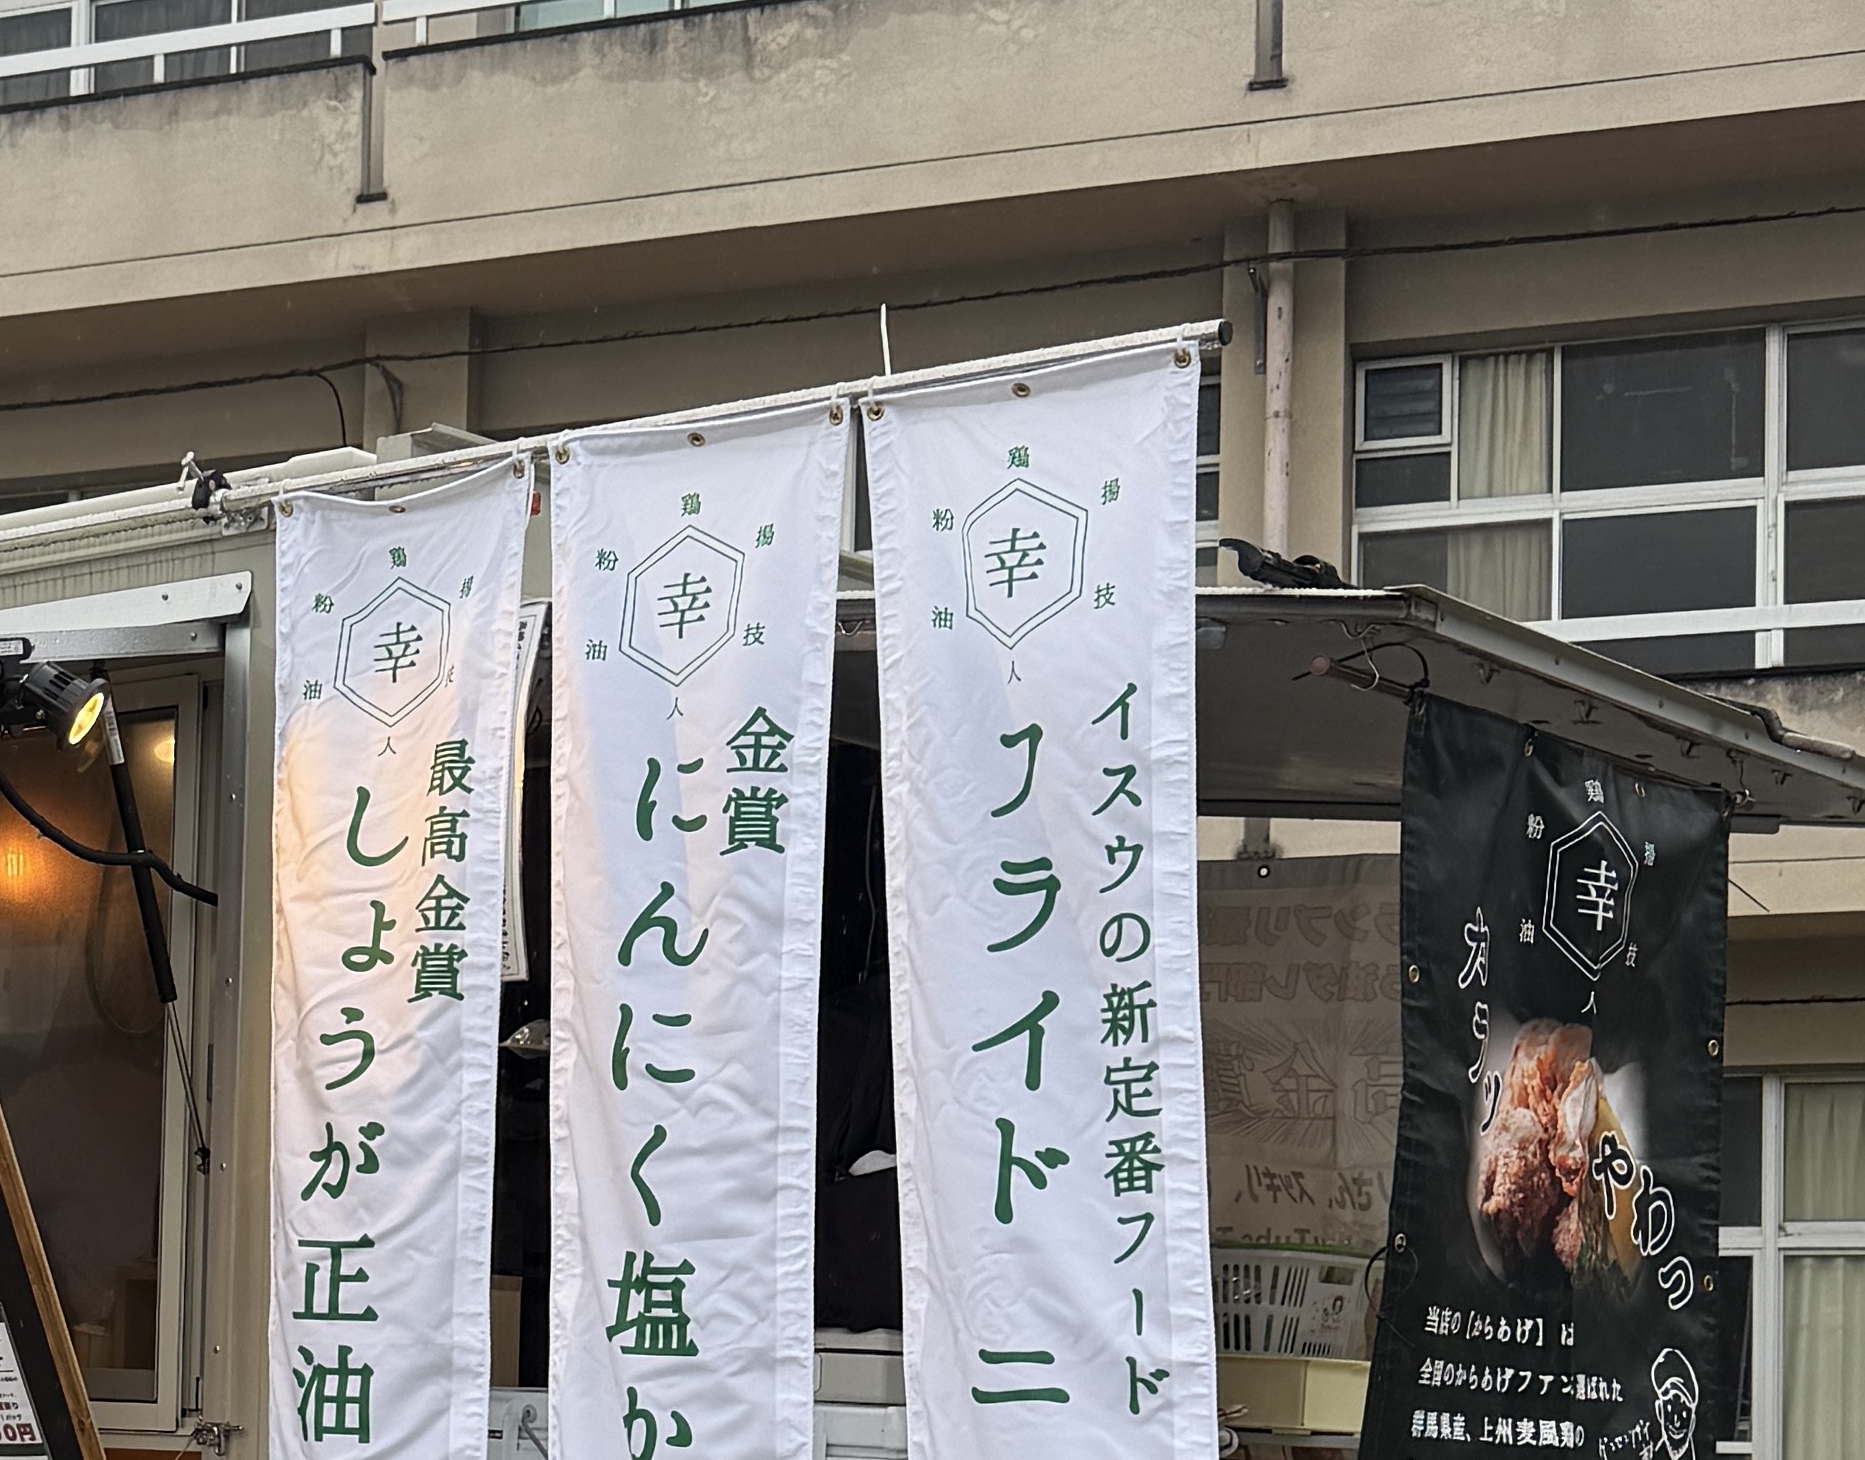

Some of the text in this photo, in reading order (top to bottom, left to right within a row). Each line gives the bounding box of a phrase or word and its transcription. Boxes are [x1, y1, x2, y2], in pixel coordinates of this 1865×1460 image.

[932, 508, 954, 532] 粉
[595, 548, 619, 572] 粉
[984, 527, 1047, 599] 幸
[312, 592, 334, 613] 粉
[657, 572, 713, 639] 幸
[1093, 583, 1116, 609] 技
[931, 606, 954, 630] 油
[742, 623, 766, 647] 技
[373, 621, 423, 683] 幸
[584, 639, 608, 662] 油
[1006, 660, 1021, 685] 人
[302, 679, 323, 701] 油
[666, 697, 685, 720] 人
[377, 737, 397, 757] 人
[720, 706, 794, 856] 金賞
[1526, 814, 1545, 840] 粉
[407, 738, 475, 1003] 最高金賞
[1576, 860, 1619, 931] 幸
[1519, 919, 1534, 944] 油
[1091, 682, 1170, 1415] イスウの新定番フード
